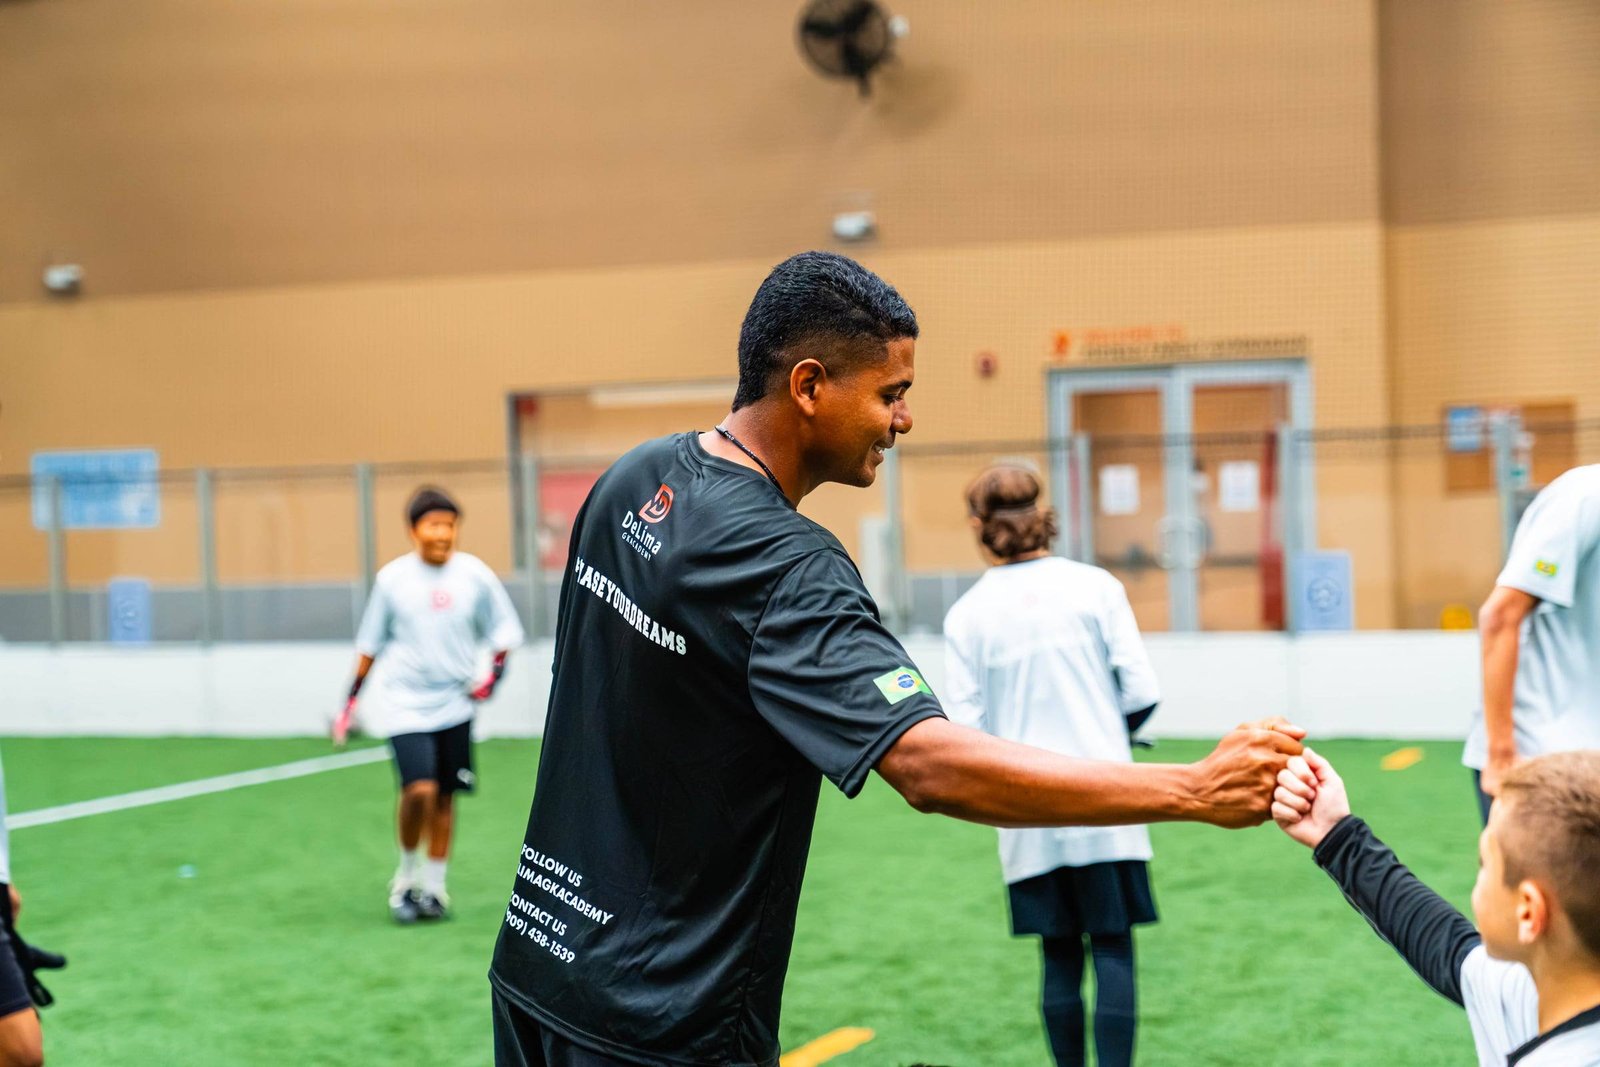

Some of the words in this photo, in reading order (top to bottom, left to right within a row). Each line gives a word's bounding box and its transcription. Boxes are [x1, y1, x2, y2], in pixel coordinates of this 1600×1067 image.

[621, 510, 662, 555] DeLima
[567, 869, 583, 887] US
[551, 919, 567, 936] US
[528, 927, 576, 964] 438-1539
